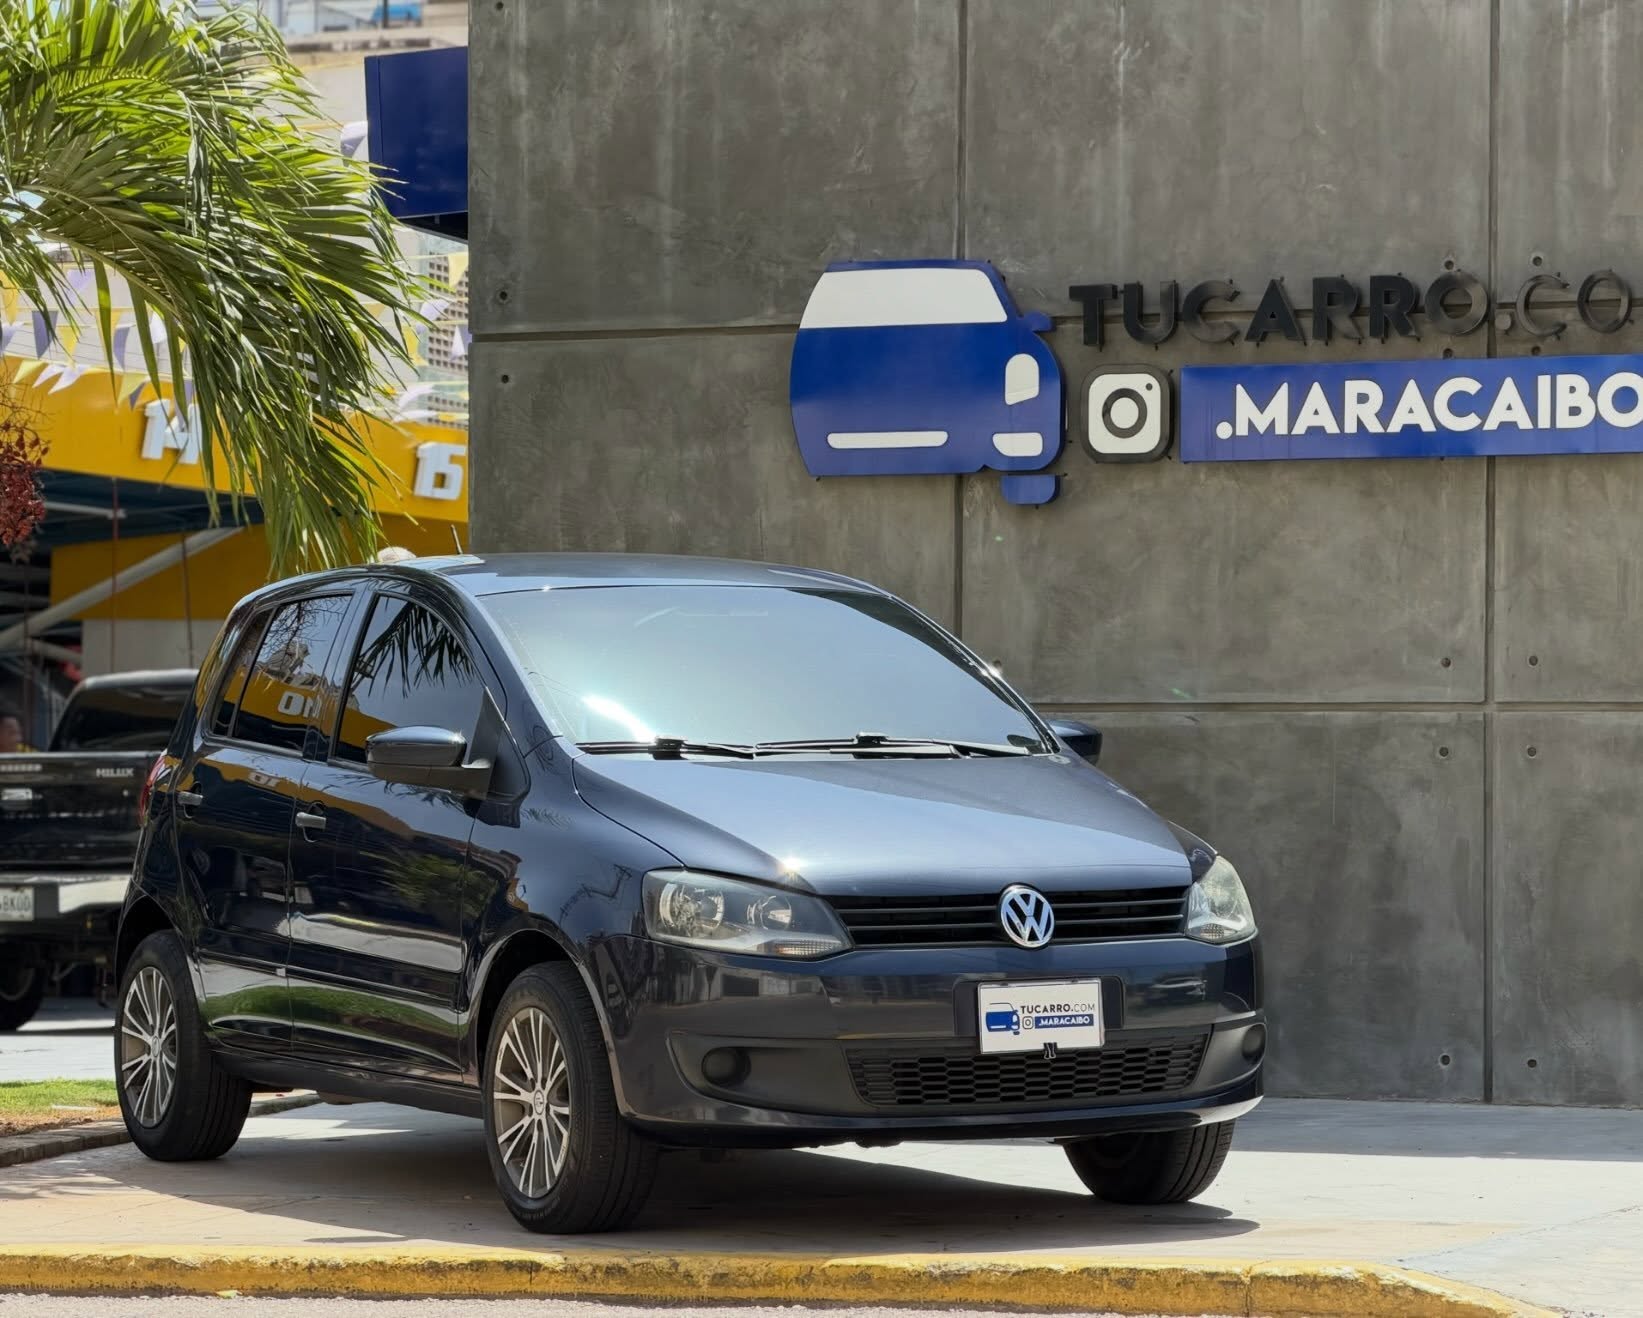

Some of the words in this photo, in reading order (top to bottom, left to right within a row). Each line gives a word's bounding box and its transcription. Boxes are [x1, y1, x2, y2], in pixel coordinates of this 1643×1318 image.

[1068, 268, 1634, 348] TUCARRO.CO
[1215, 371, 1643, 440] .MARACAIBO
[413, 441, 467, 500] 16
[95, 767, 134, 778] HILUX
[1001, 886, 1054, 947] VW
[1020, 1003, 1096, 1015] TUCARRO.COM
[1038, 1015, 1091, 1027] .MARACAIBO
